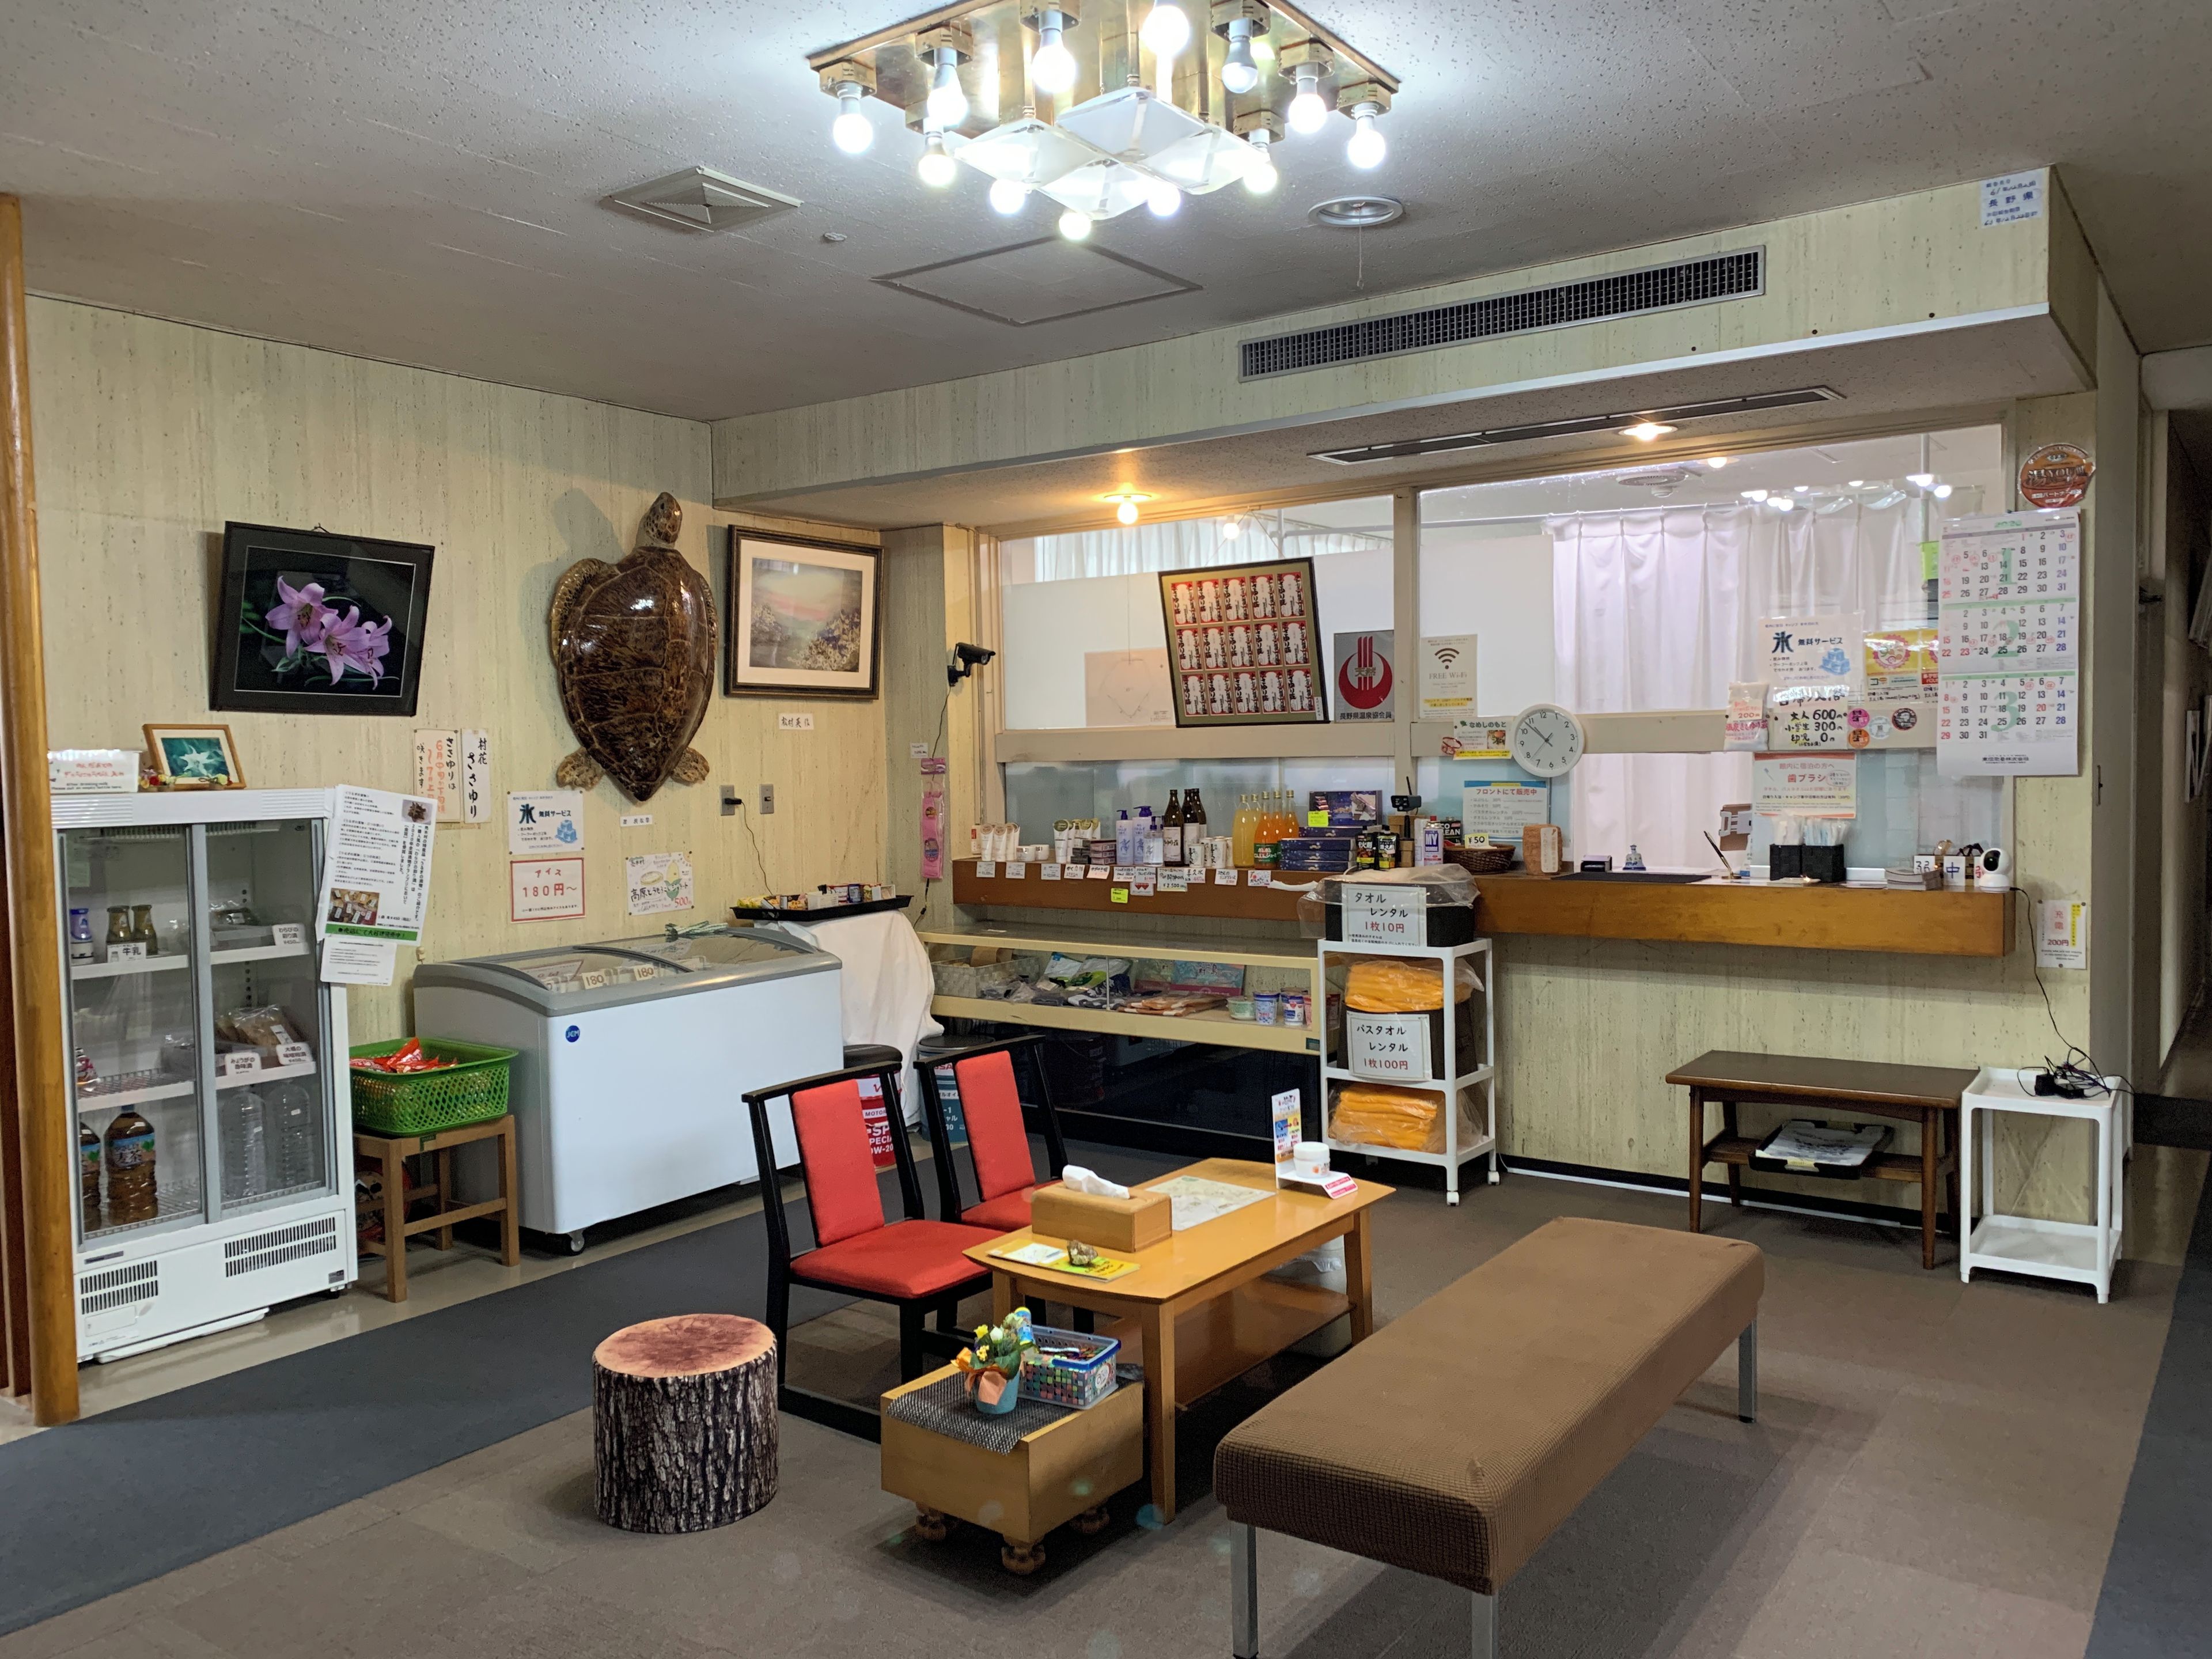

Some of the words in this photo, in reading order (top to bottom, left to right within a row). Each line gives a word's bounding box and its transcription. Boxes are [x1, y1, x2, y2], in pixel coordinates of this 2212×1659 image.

[1979, 588, 1988, 596] 27
[1772, 631, 1794, 653] 氷
[1798, 637, 1843, 646] 無料サービス
[2036, 644, 2046, 652] 27
[1355, 666, 1377, 677] 天然
[1340, 711, 1392, 720] 長野県温泉協会員
[1790, 711, 1809, 721] 大人
[1785, 722, 1809, 732] 小学生
[478, 737, 487, 765] 村花
[446, 737, 456, 790] ささゆりは
[1535, 759, 1540, 767] 7
[1787, 774, 1827, 783] 歯ブラシ
[519, 804, 536, 824] 氷
[1426, 834, 1438, 845] MY
[535, 868, 561, 878] アイス
[1355, 892, 1386, 903] タオル
[1370, 908, 1408, 918] レンタル
[1365, 921, 1404, 933] 1枚10円
[123, 947, 141, 956] 牛乳
[637, 967, 654, 978] 180
[586, 975, 604, 986] 180
[1357, 1024, 1406, 1035] バスタオル
[1369, 1041, 1408, 1052] レンタル
[1364, 1058, 1408, 1070] 1枚100円
[871, 1143, 893, 1154] W-20
